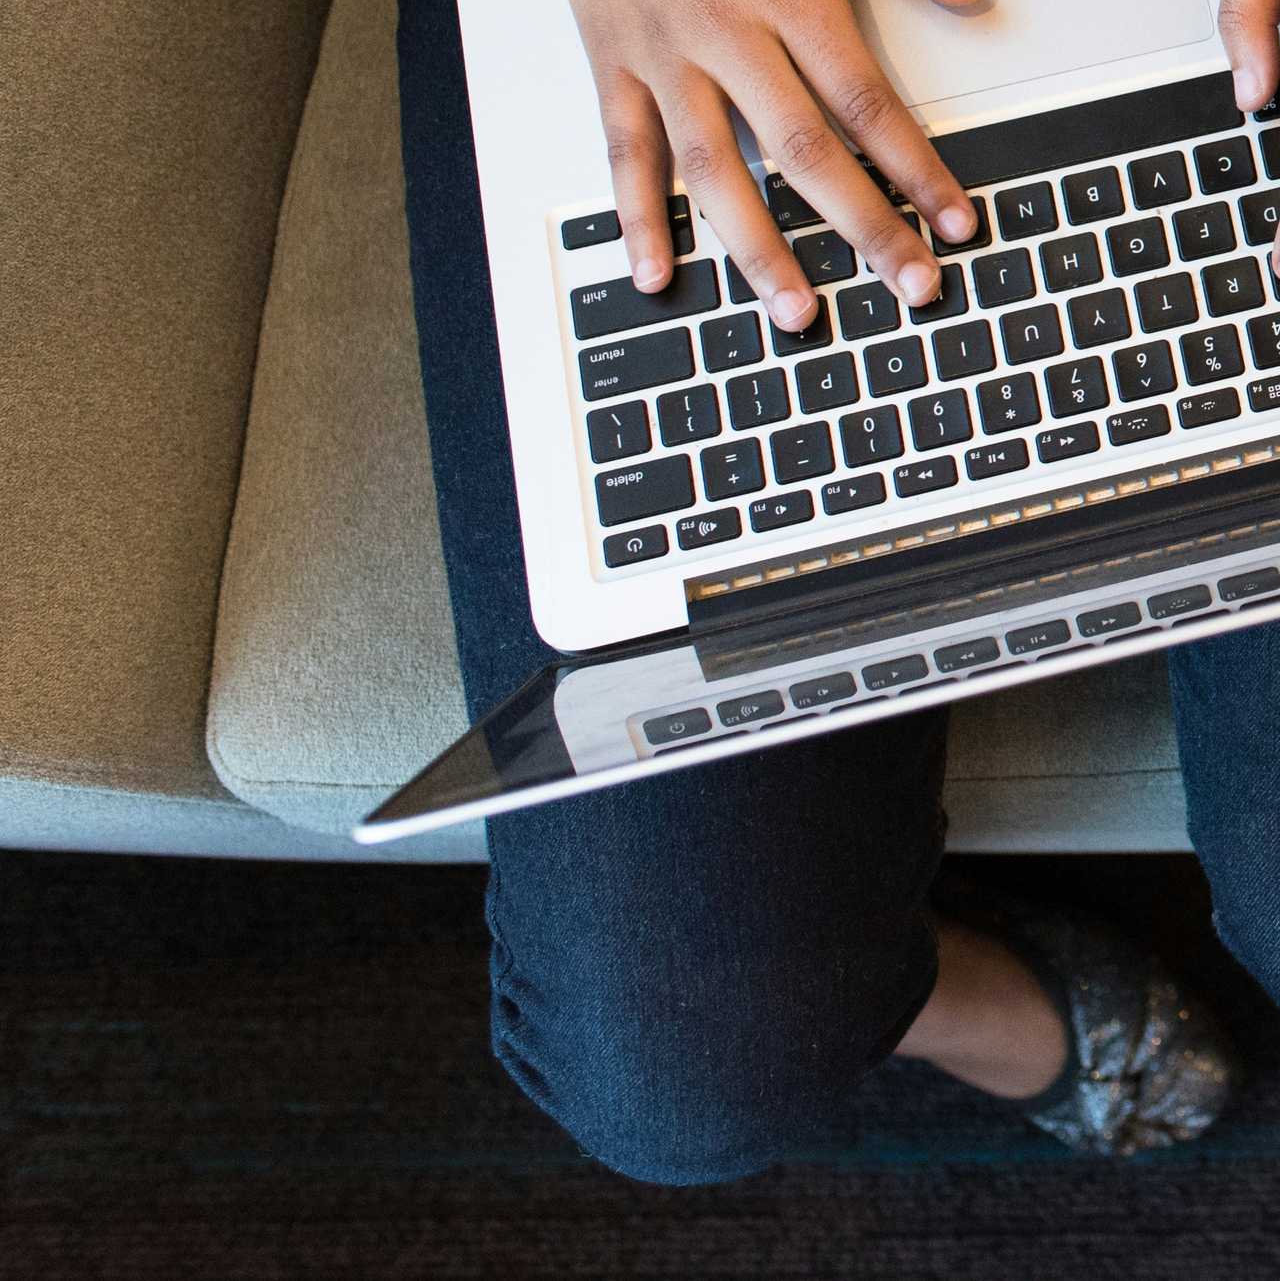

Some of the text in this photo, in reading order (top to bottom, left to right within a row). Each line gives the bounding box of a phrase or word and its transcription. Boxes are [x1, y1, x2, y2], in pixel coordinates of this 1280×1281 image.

[1218, 156, 1232, 172] C
[1153, 171, 1167, 188] V
[1086, 186, 1100, 202] B
[1018, 201, 1034, 219] N
[1263, 206, 1278, 223] D
[1199, 222, 1210, 239] F
[1129, 237, 1145, 254] G
[1062, 252, 1079, 270] H
[999, 268, 1008, 285] J
[1226, 277, 1239, 294] R
[581, 289, 608, 304] shift
[1161, 294, 1173, 311] T
[861, 300, 874, 315] L
[1093, 309, 1106, 326] Y
[1024, 324, 1040, 342] U
[1203, 336, 1214, 353] 5
[588, 347, 625, 362] return
[1136, 352, 1147, 368] 6
[1205, 356, 1222, 372] %
[593, 376, 619, 388] enter
[820, 373, 833, 390] P
[1071, 367, 1081, 384] 7
[1000, 384, 1012, 400] 8
[1071, 388, 1085, 403] &
[1252, 384, 1263, 394] F4
[933, 400, 944, 416] 9
[1182, 401, 1193, 410] F5
[1111, 418, 1123, 427] F6
[1041, 434, 1052, 444] F7
[969, 451, 981, 460] F8
[605, 471, 644, 486] delete
[898, 469, 909, 478] F9
[827, 485, 841, 495] F10
[753, 503, 767, 513] F11
[680, 521, 695, 531] F12
